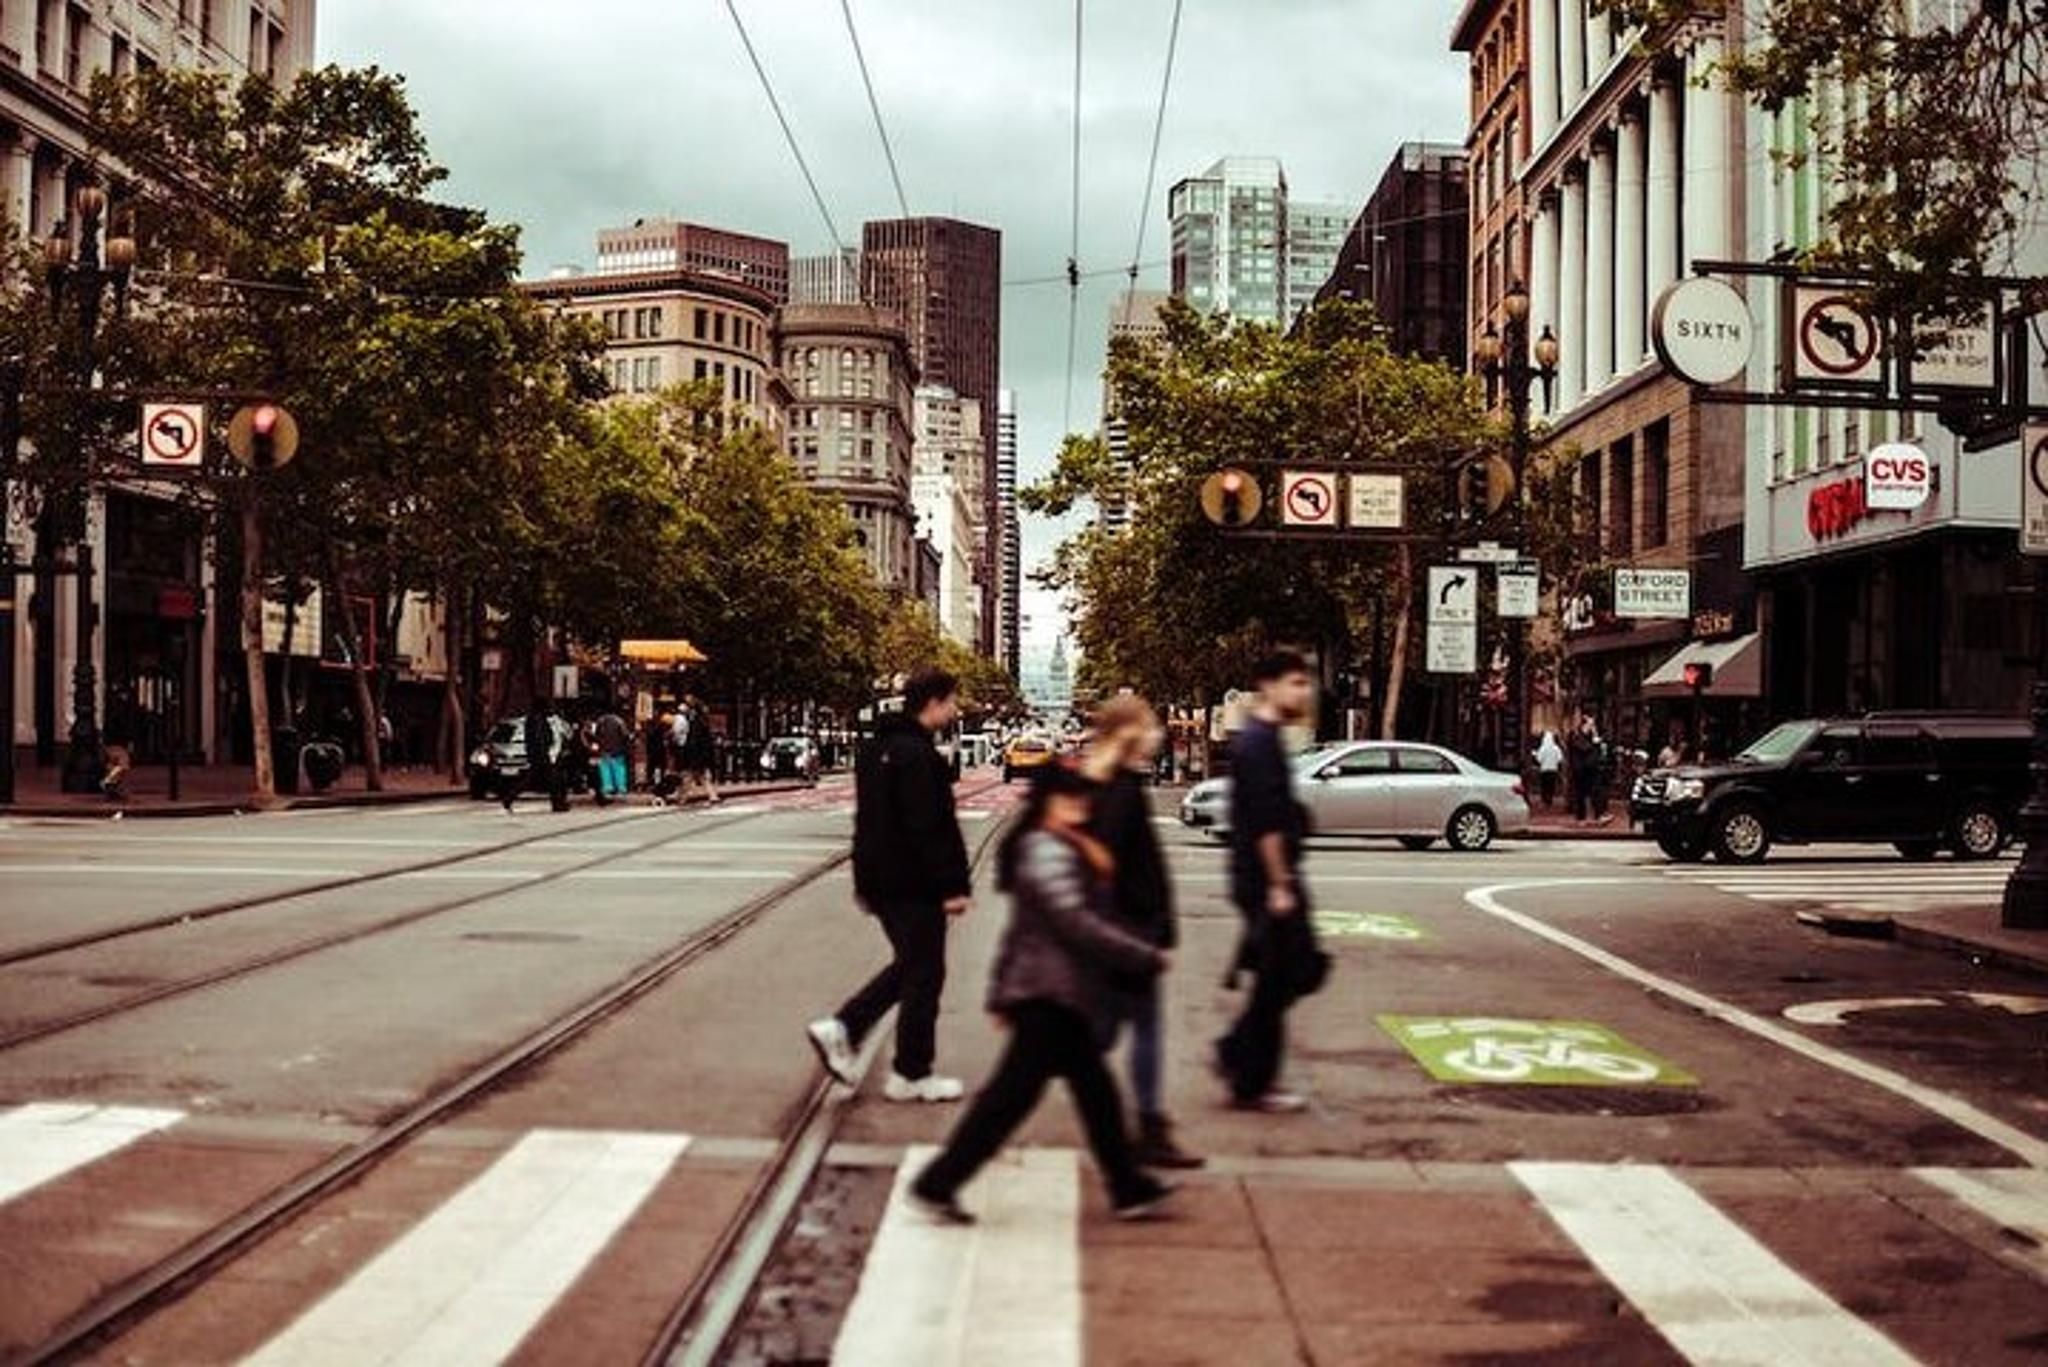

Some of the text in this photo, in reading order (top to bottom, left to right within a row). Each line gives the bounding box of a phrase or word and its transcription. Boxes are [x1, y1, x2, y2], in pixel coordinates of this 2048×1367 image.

[1871, 458, 1926, 482] CVS
[1618, 573, 1687, 588] OXFORD
[1620, 589, 1684, 602] STREET
